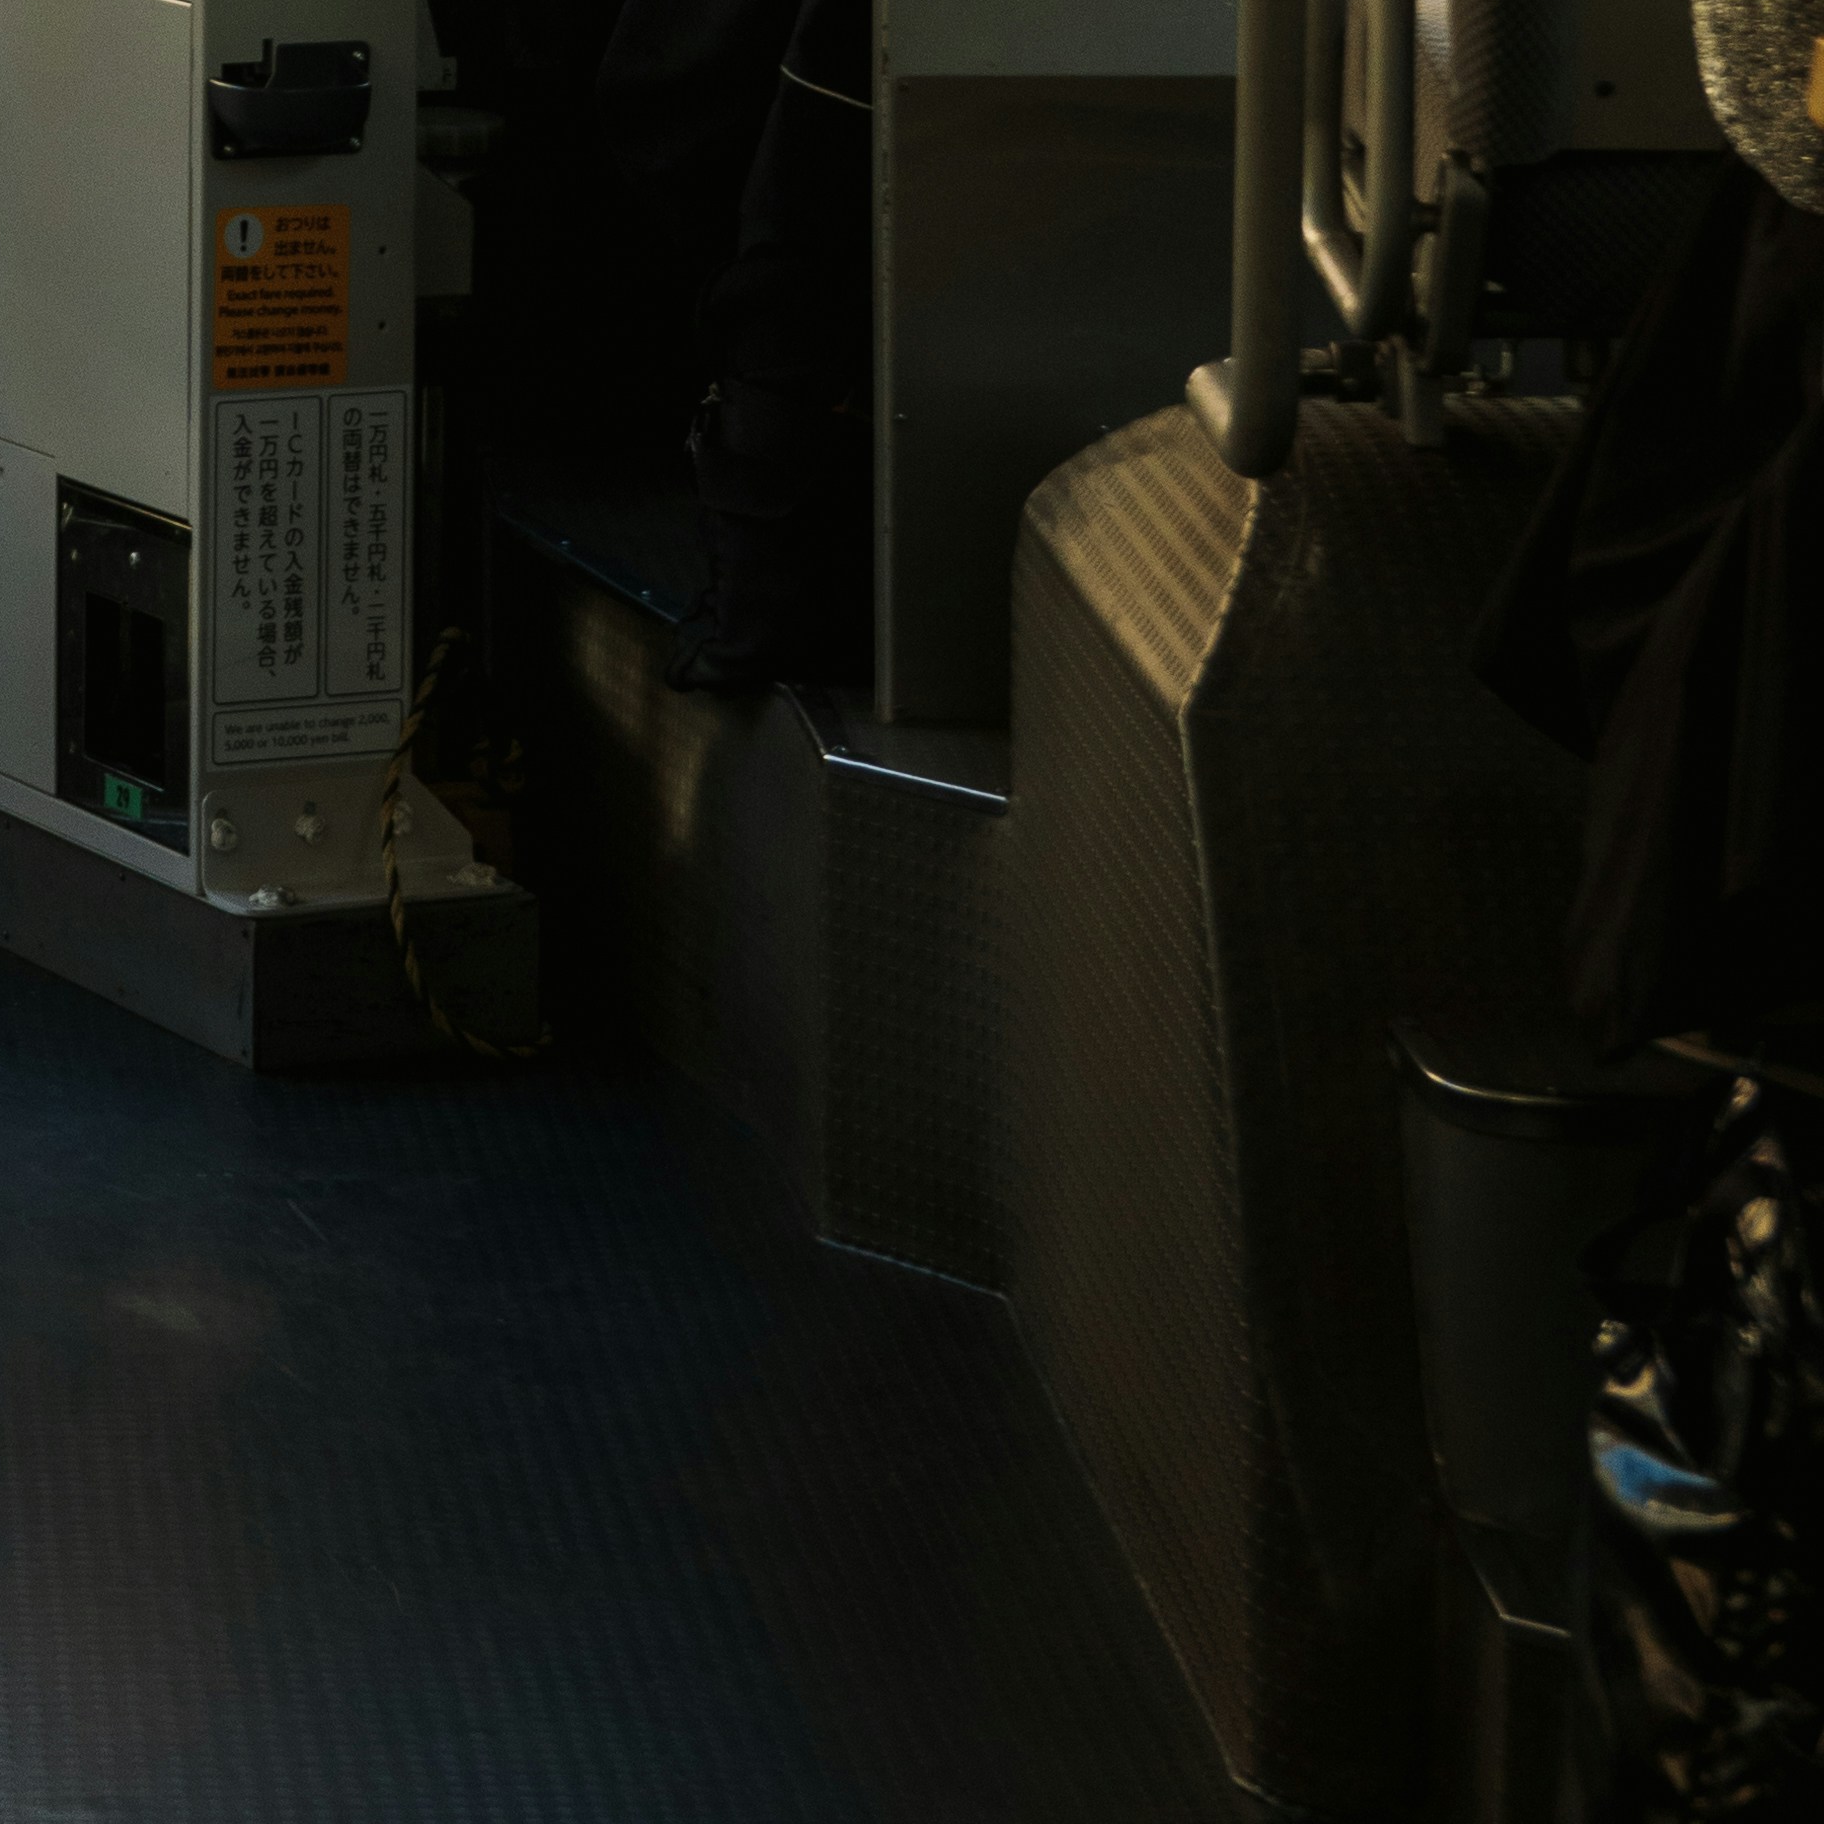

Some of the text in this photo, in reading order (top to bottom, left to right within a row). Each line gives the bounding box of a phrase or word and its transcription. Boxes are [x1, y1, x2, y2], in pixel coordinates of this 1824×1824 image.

[274, 215, 331, 233] おつりは
[273, 239, 337, 257] 出ません。
[226, 289, 257, 302] Exact
[259, 288, 282, 300] fare
[218, 305, 254, 318] Please
[256, 305, 299, 318] change
[231, 413, 253, 611] 入金ができません。
[340, 406, 364, 616] の両替はできません。
[256, 419, 280, 678] 一万円を超えている場合、
[282, 411, 305, 667] ICカードの入金残額が
[365, 411, 390, 682] 一万円札・五千円札・二千円札
[224, 723, 242, 736] We
[244, 723, 263, 734] are
[265, 719, 301, 733] unable
[304, 719, 316, 731] to
[318, 716, 355, 731] change
[224, 739, 255, 753] 5,000
[256, 740, 268, 749] or
[272, 735, 308, 748] 10,000
[309, 733, 329, 746] yen
[116, 784, 131, 810] 29
